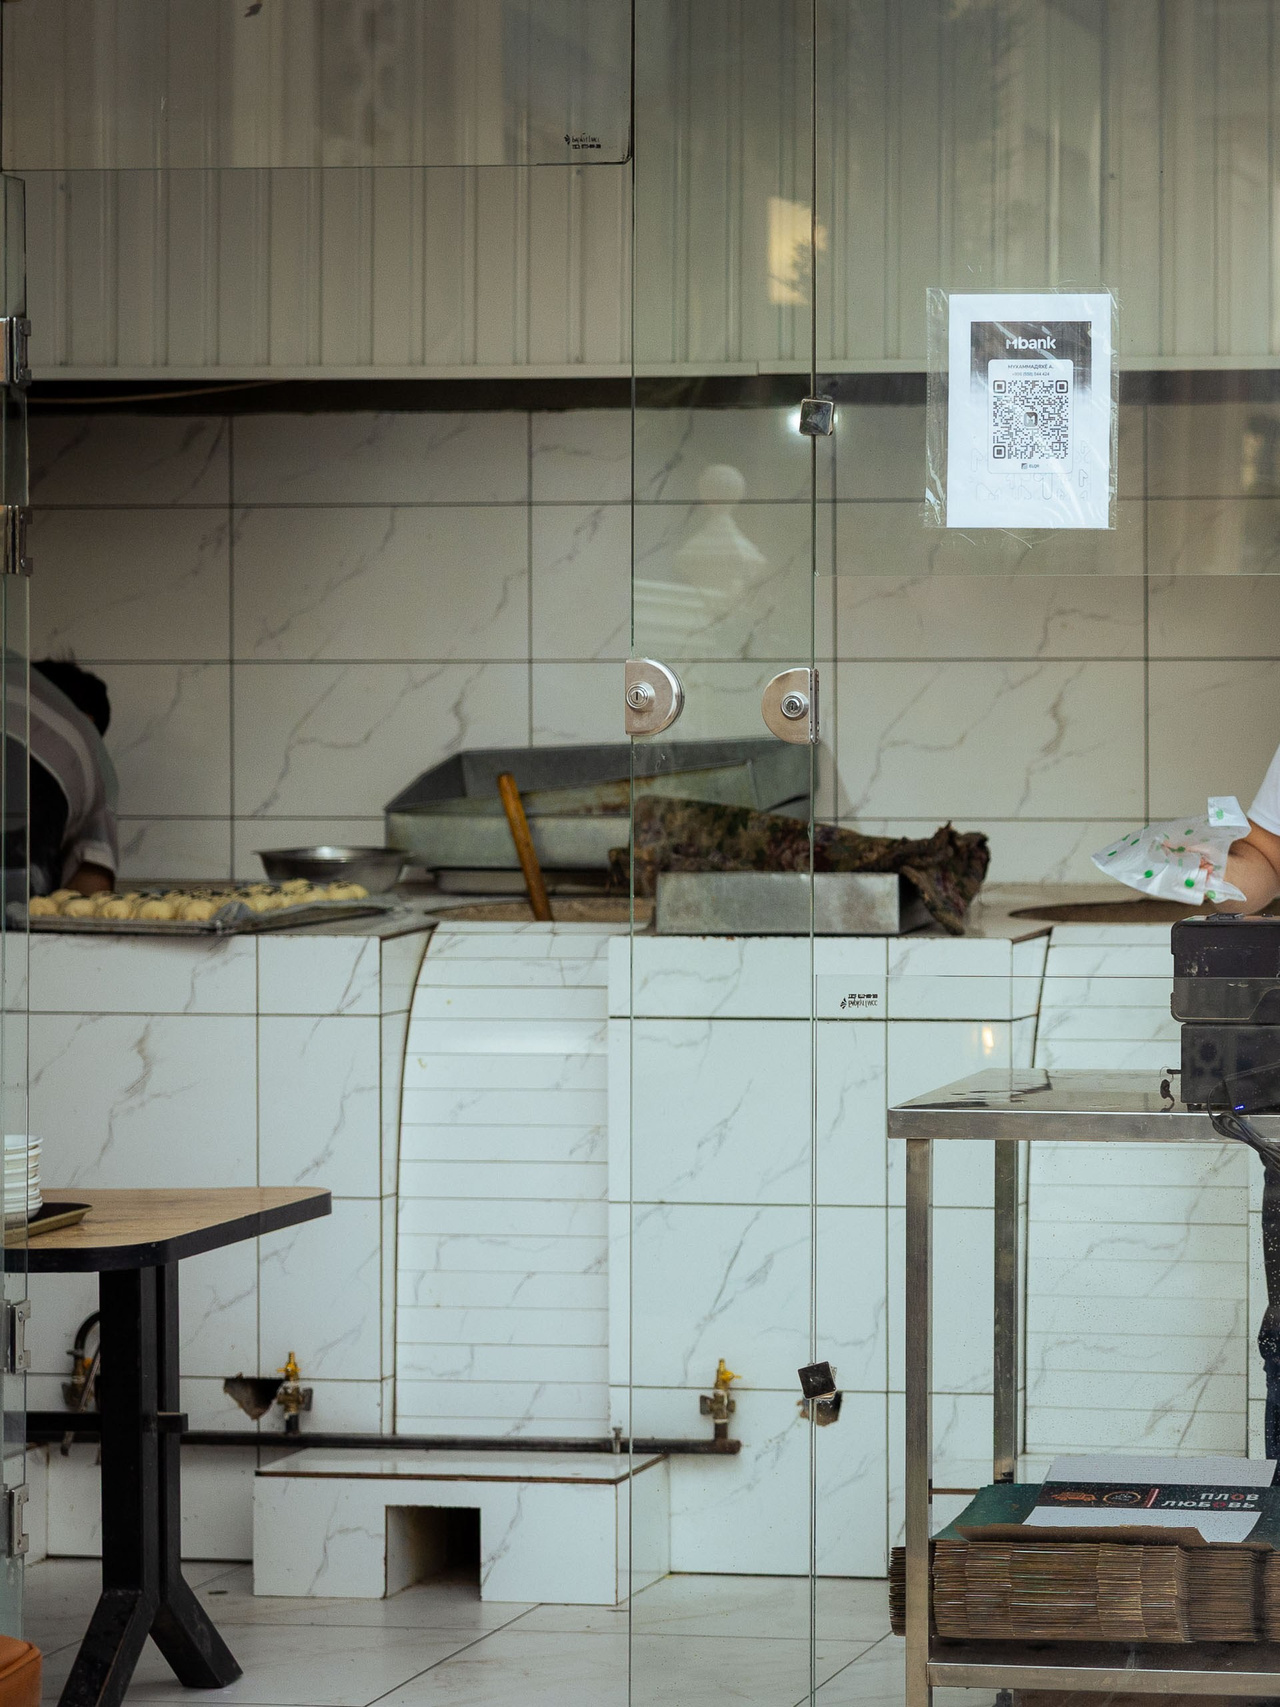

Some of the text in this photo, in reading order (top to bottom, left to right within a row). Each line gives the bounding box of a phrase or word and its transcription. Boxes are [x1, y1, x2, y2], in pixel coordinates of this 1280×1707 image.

[1006, 336, 1057, 350] Mbank
[1199, 1492, 1260, 1502] ПЛОВ
[1160, 1500, 1255, 1509] ЛЮБОВЬ
